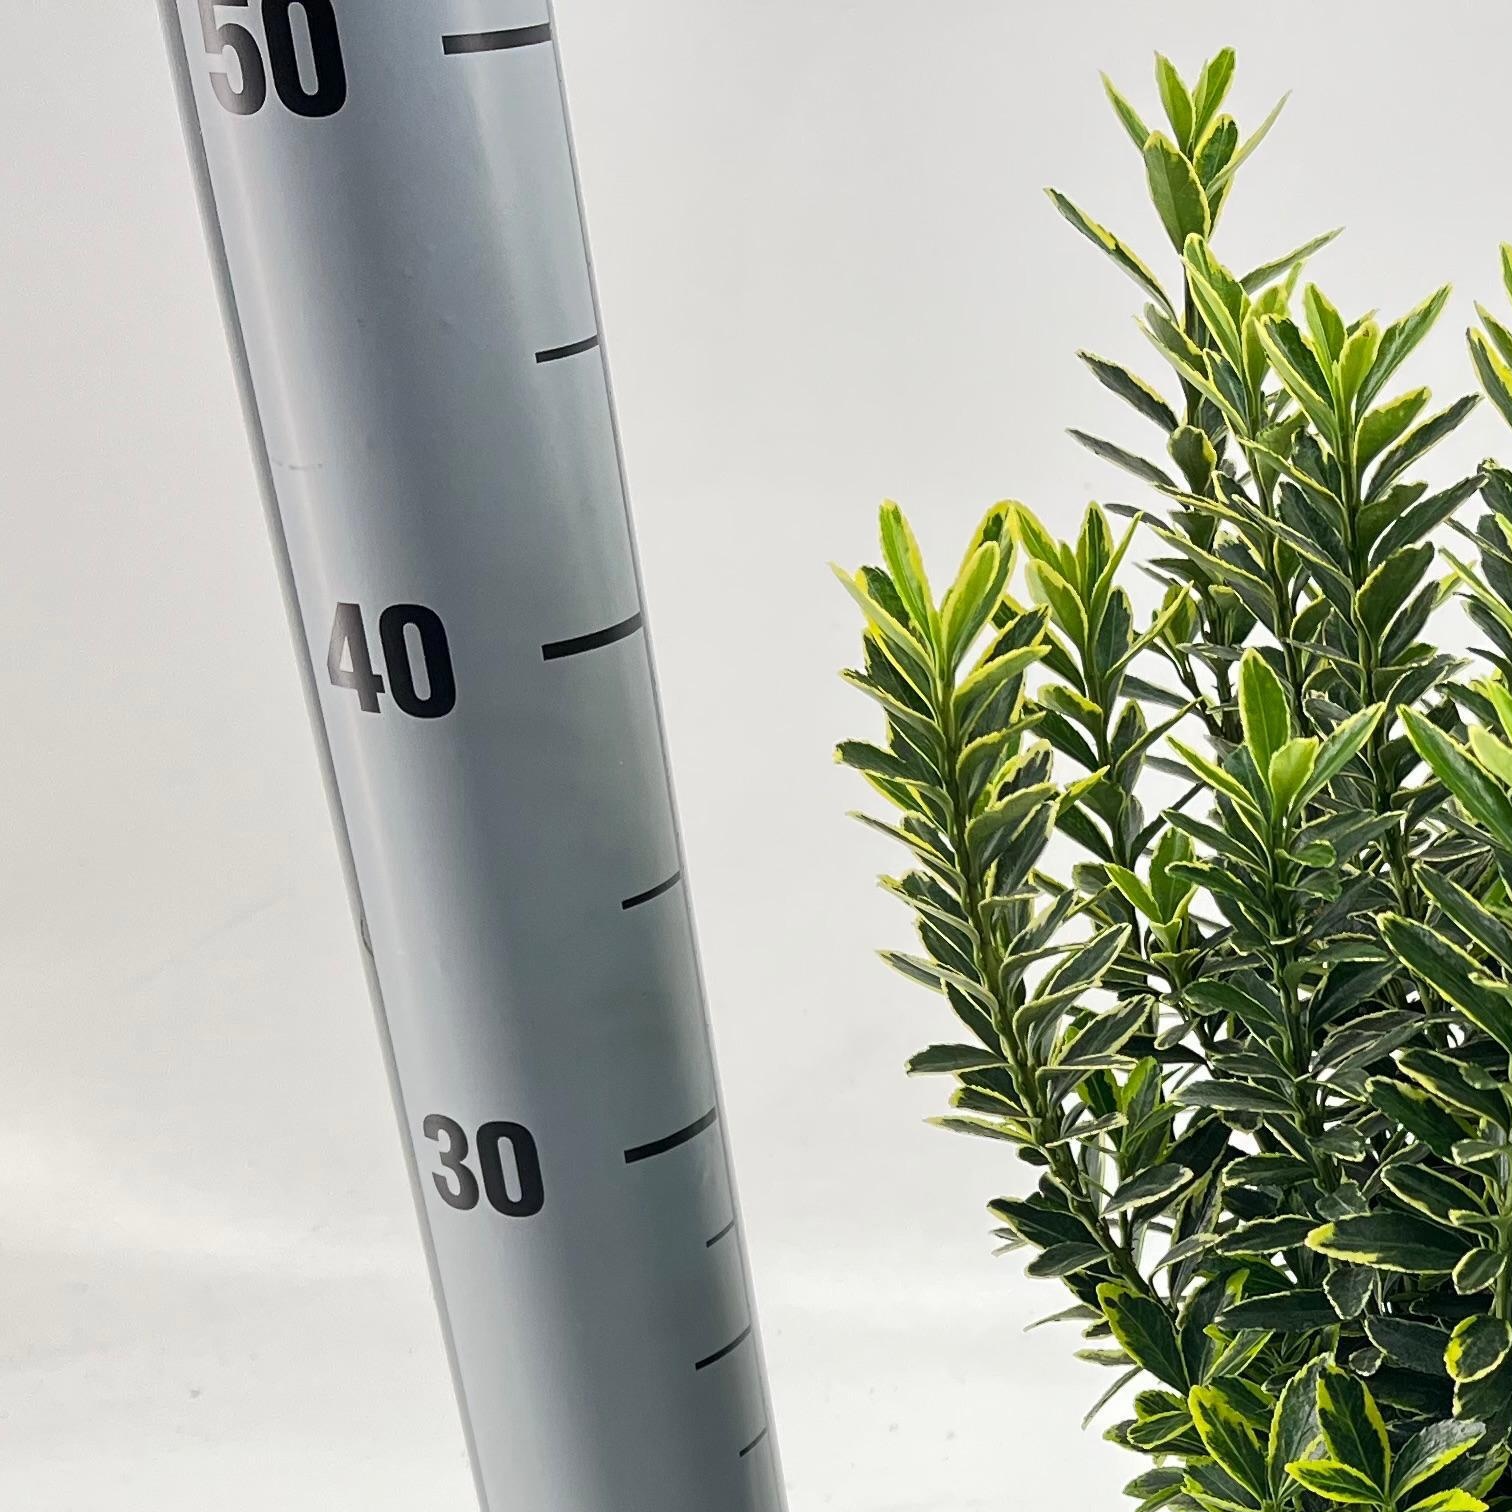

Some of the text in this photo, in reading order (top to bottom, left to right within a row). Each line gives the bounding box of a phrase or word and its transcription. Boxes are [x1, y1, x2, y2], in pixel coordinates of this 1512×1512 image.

[200, 0, 347, 118] 50
[326, 601, 457, 720] 40
[422, 1113, 545, 1218] 30
